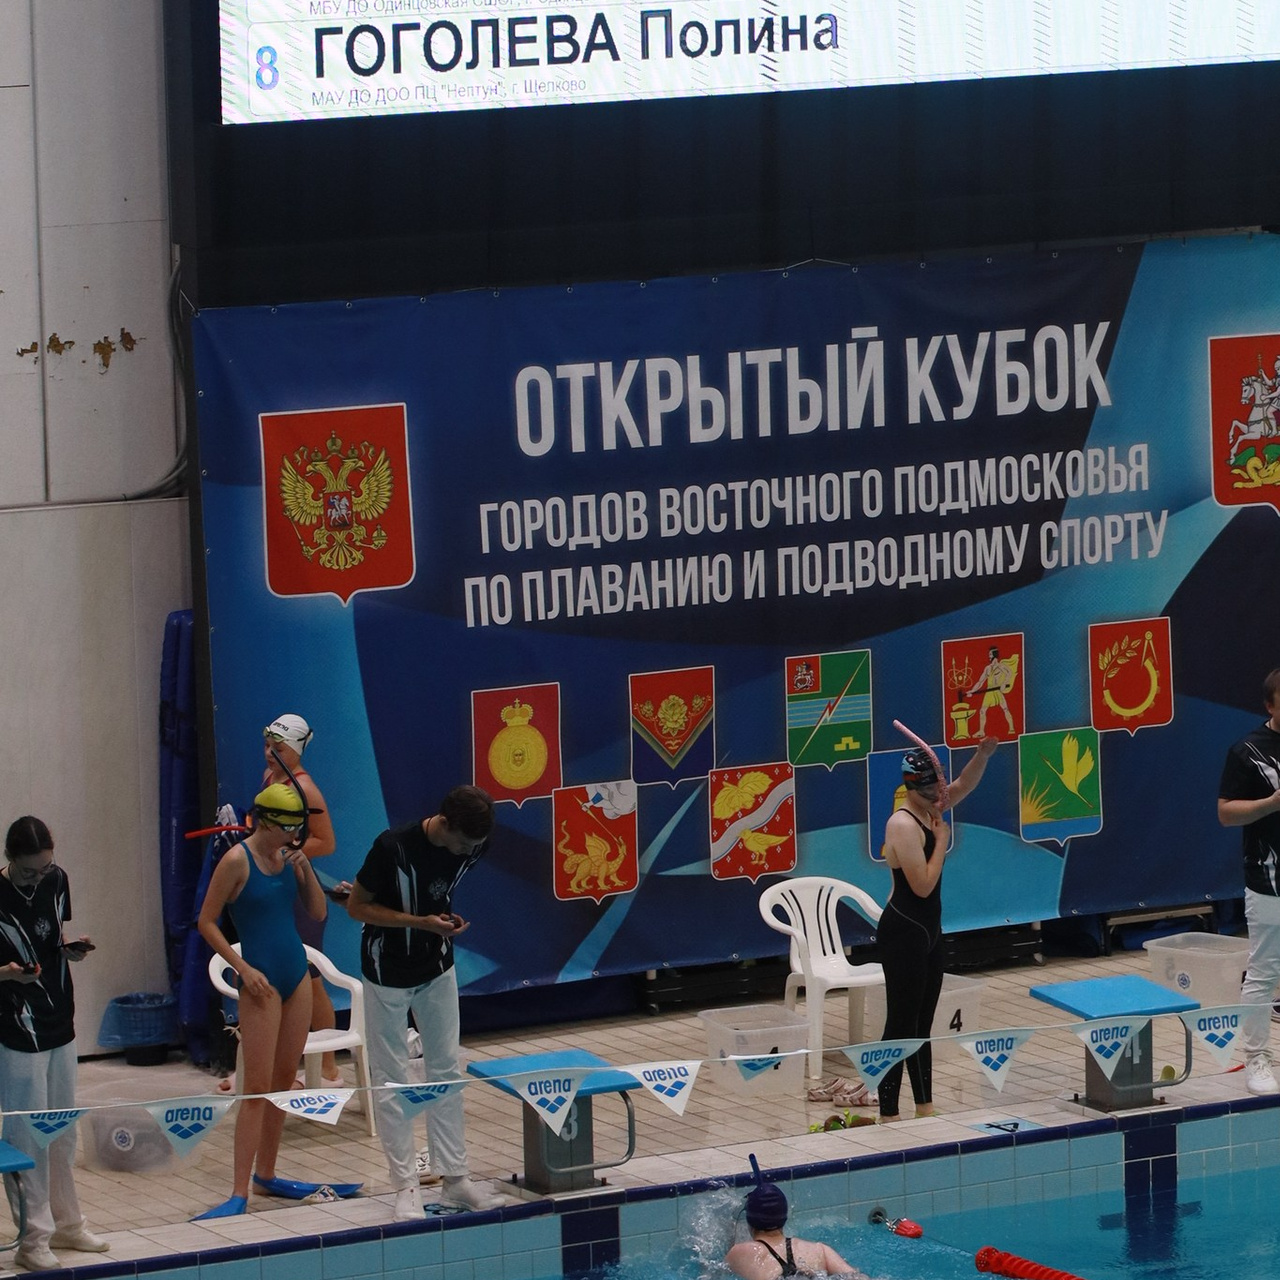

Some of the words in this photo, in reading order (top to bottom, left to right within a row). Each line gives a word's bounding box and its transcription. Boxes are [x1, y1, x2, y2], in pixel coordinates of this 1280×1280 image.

[309, 0, 342, 16] МБУ
[255, 45, 279, 90] 8
[315, 12, 620, 78] ГОГОЛЕВА
[640, 9, 840, 60] Полина
[311, 90, 344, 106] МАУ
[524, 79, 587, 95] Щелково
[514, 326, 885, 458] ОТКРЫТЫЙ
[905, 321, 1112, 425] КУБОК
[479, 491, 649, 555] ГОРОДОВ
[660, 466, 883, 539] ВОСТОЧНОГО
[894, 443, 1149, 515] ПОДМОСКОВЬЯ
[464, 574, 512, 629] ПО
[521, 553, 733, 623] ПЛАВАНИЮ
[744, 550, 767, 600] И
[776, 523, 1031, 598] ПОДВОДНОМУ
[1039, 509, 1169, 571] СПОРТУ
[949, 1008, 963, 1032] 4
[1198, 1014, 1239, 1032] arena
[1090, 1026, 1130, 1044] arena
[976, 1037, 1014, 1055] arena
[861, 1048, 903, 1065] arena
[642, 1064, 689, 1082] arena
[528, 1077, 572, 1096] arena
[290, 1094, 338, 1110] arena
[165, 1106, 213, 1123] arena
